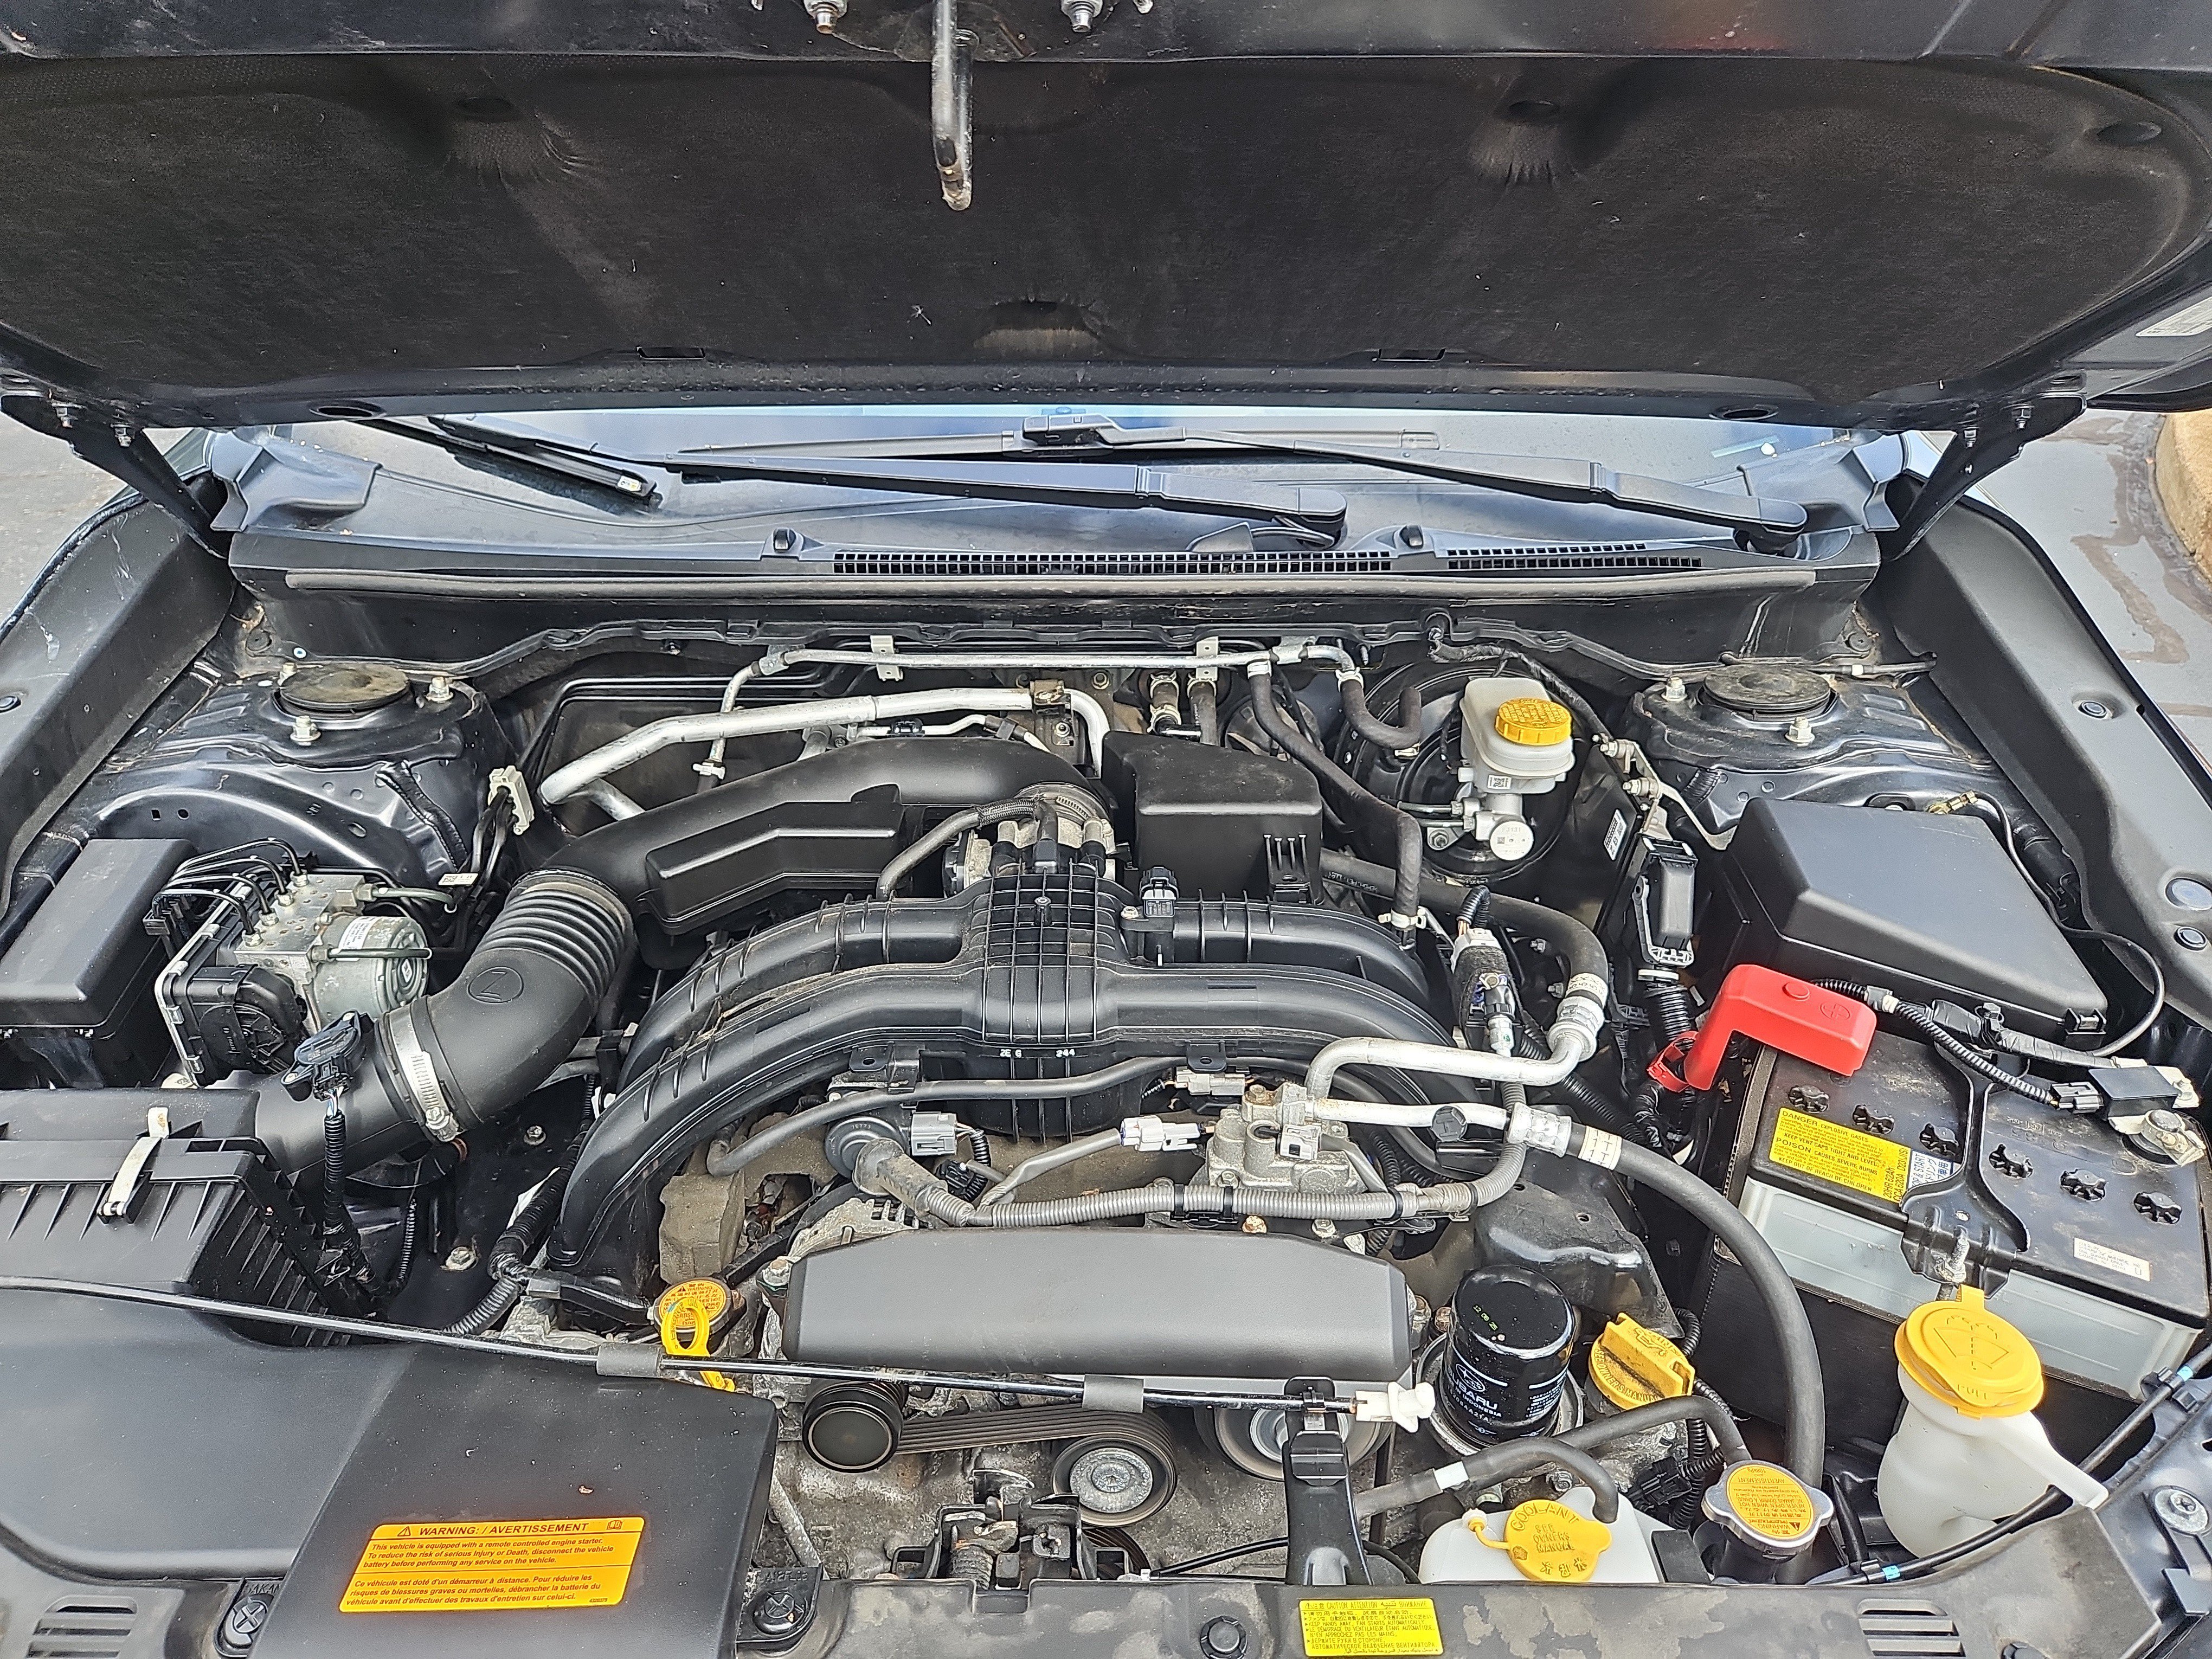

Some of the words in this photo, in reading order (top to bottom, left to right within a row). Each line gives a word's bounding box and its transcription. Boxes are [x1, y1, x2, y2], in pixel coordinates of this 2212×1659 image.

[1783, 1111, 1817, 1126] DANGER
[1821, 1124, 1849, 1136] EXPLOSIVE
[1776, 1137, 1811, 1153] POISON
[1814, 1150, 1835, 1161] CAUSES
[1837, 1158, 1857, 1168] SEVERE
[1859, 1165, 1877, 1175] BURNS
[1814, 1142, 1828, 1150] CAPS
[1830, 1147, 1846, 1156] TIGHT
[1914, 1154, 1925, 1172] START
[1815, 1169, 1833, 1178] REACH
[1843, 1179, 1872, 1191] CHILDREN
[1594, 1349, 1605, 1364] SEE
[1597, 1364, 1626, 1393] OWNER'S
[1447, 1367, 1498, 1410] SUBARU
[1625, 1387, 1660, 1403] MANUAL
[1462, 1393, 1502, 1417] INDONESIA
[1510, 1502, 1580, 1532] COOLANT
[420, 1526, 479, 1536] WARNING:
[488, 1522, 589, 1534] AVERTISSEMENT
[1535, 1523, 1555, 1534] SEE
[425, 1542, 460, 1550] equipped
[1533, 1532, 1571, 1544] OWNERS
[473, 1550, 494, 1558] Injury
[1536, 1544, 1575, 1553] MANUAL
[416, 1559, 458, 1567] performing
[1540, 1557, 1587, 1578] 冷却水
